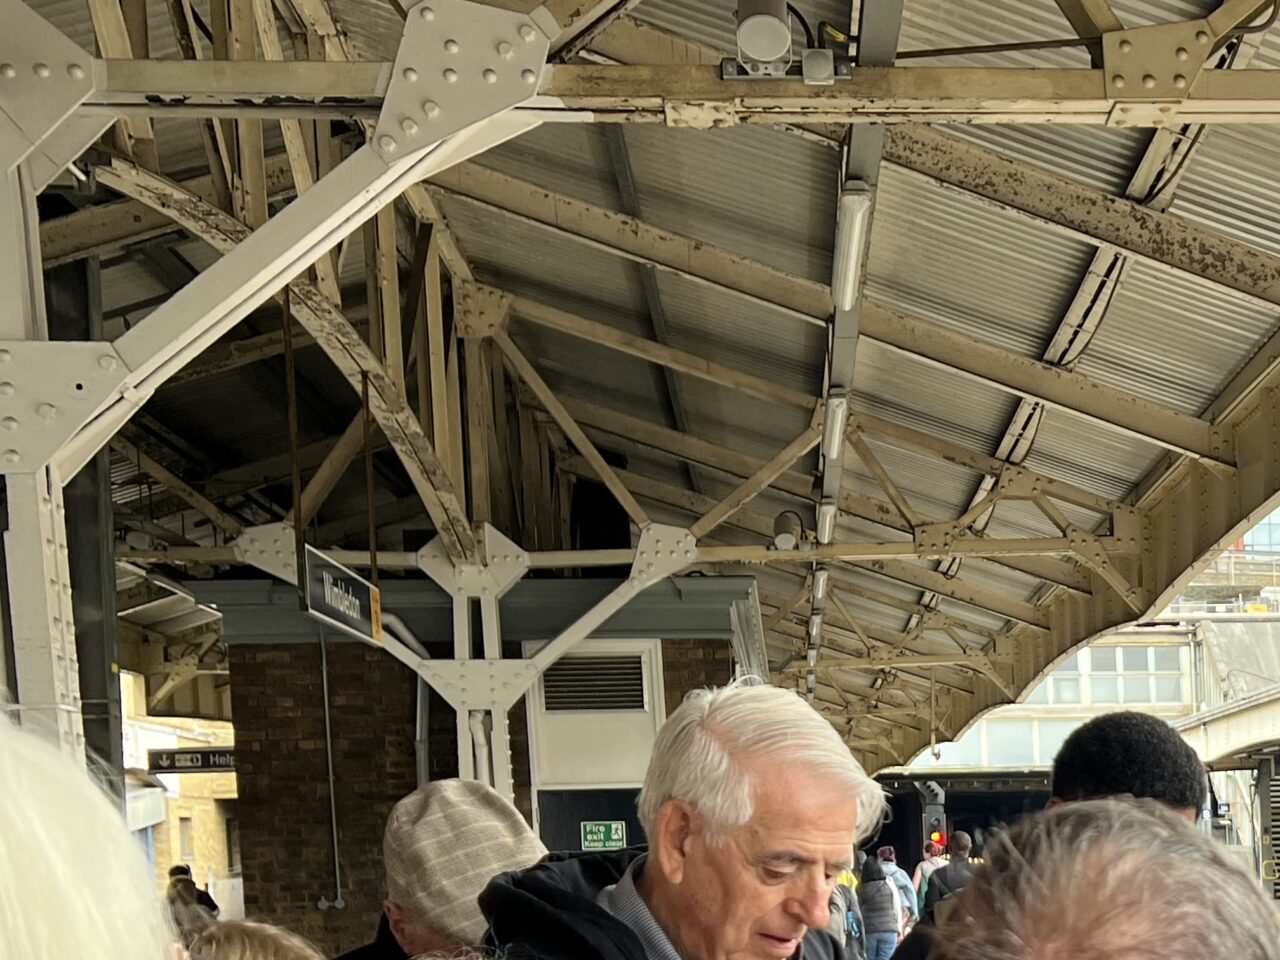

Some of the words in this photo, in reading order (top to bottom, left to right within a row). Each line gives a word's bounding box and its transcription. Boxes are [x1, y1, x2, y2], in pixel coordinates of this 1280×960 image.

[322, 570, 361, 620] Wimbledon
[586, 824, 605, 832] Fire
[586, 832, 604, 840] exit
